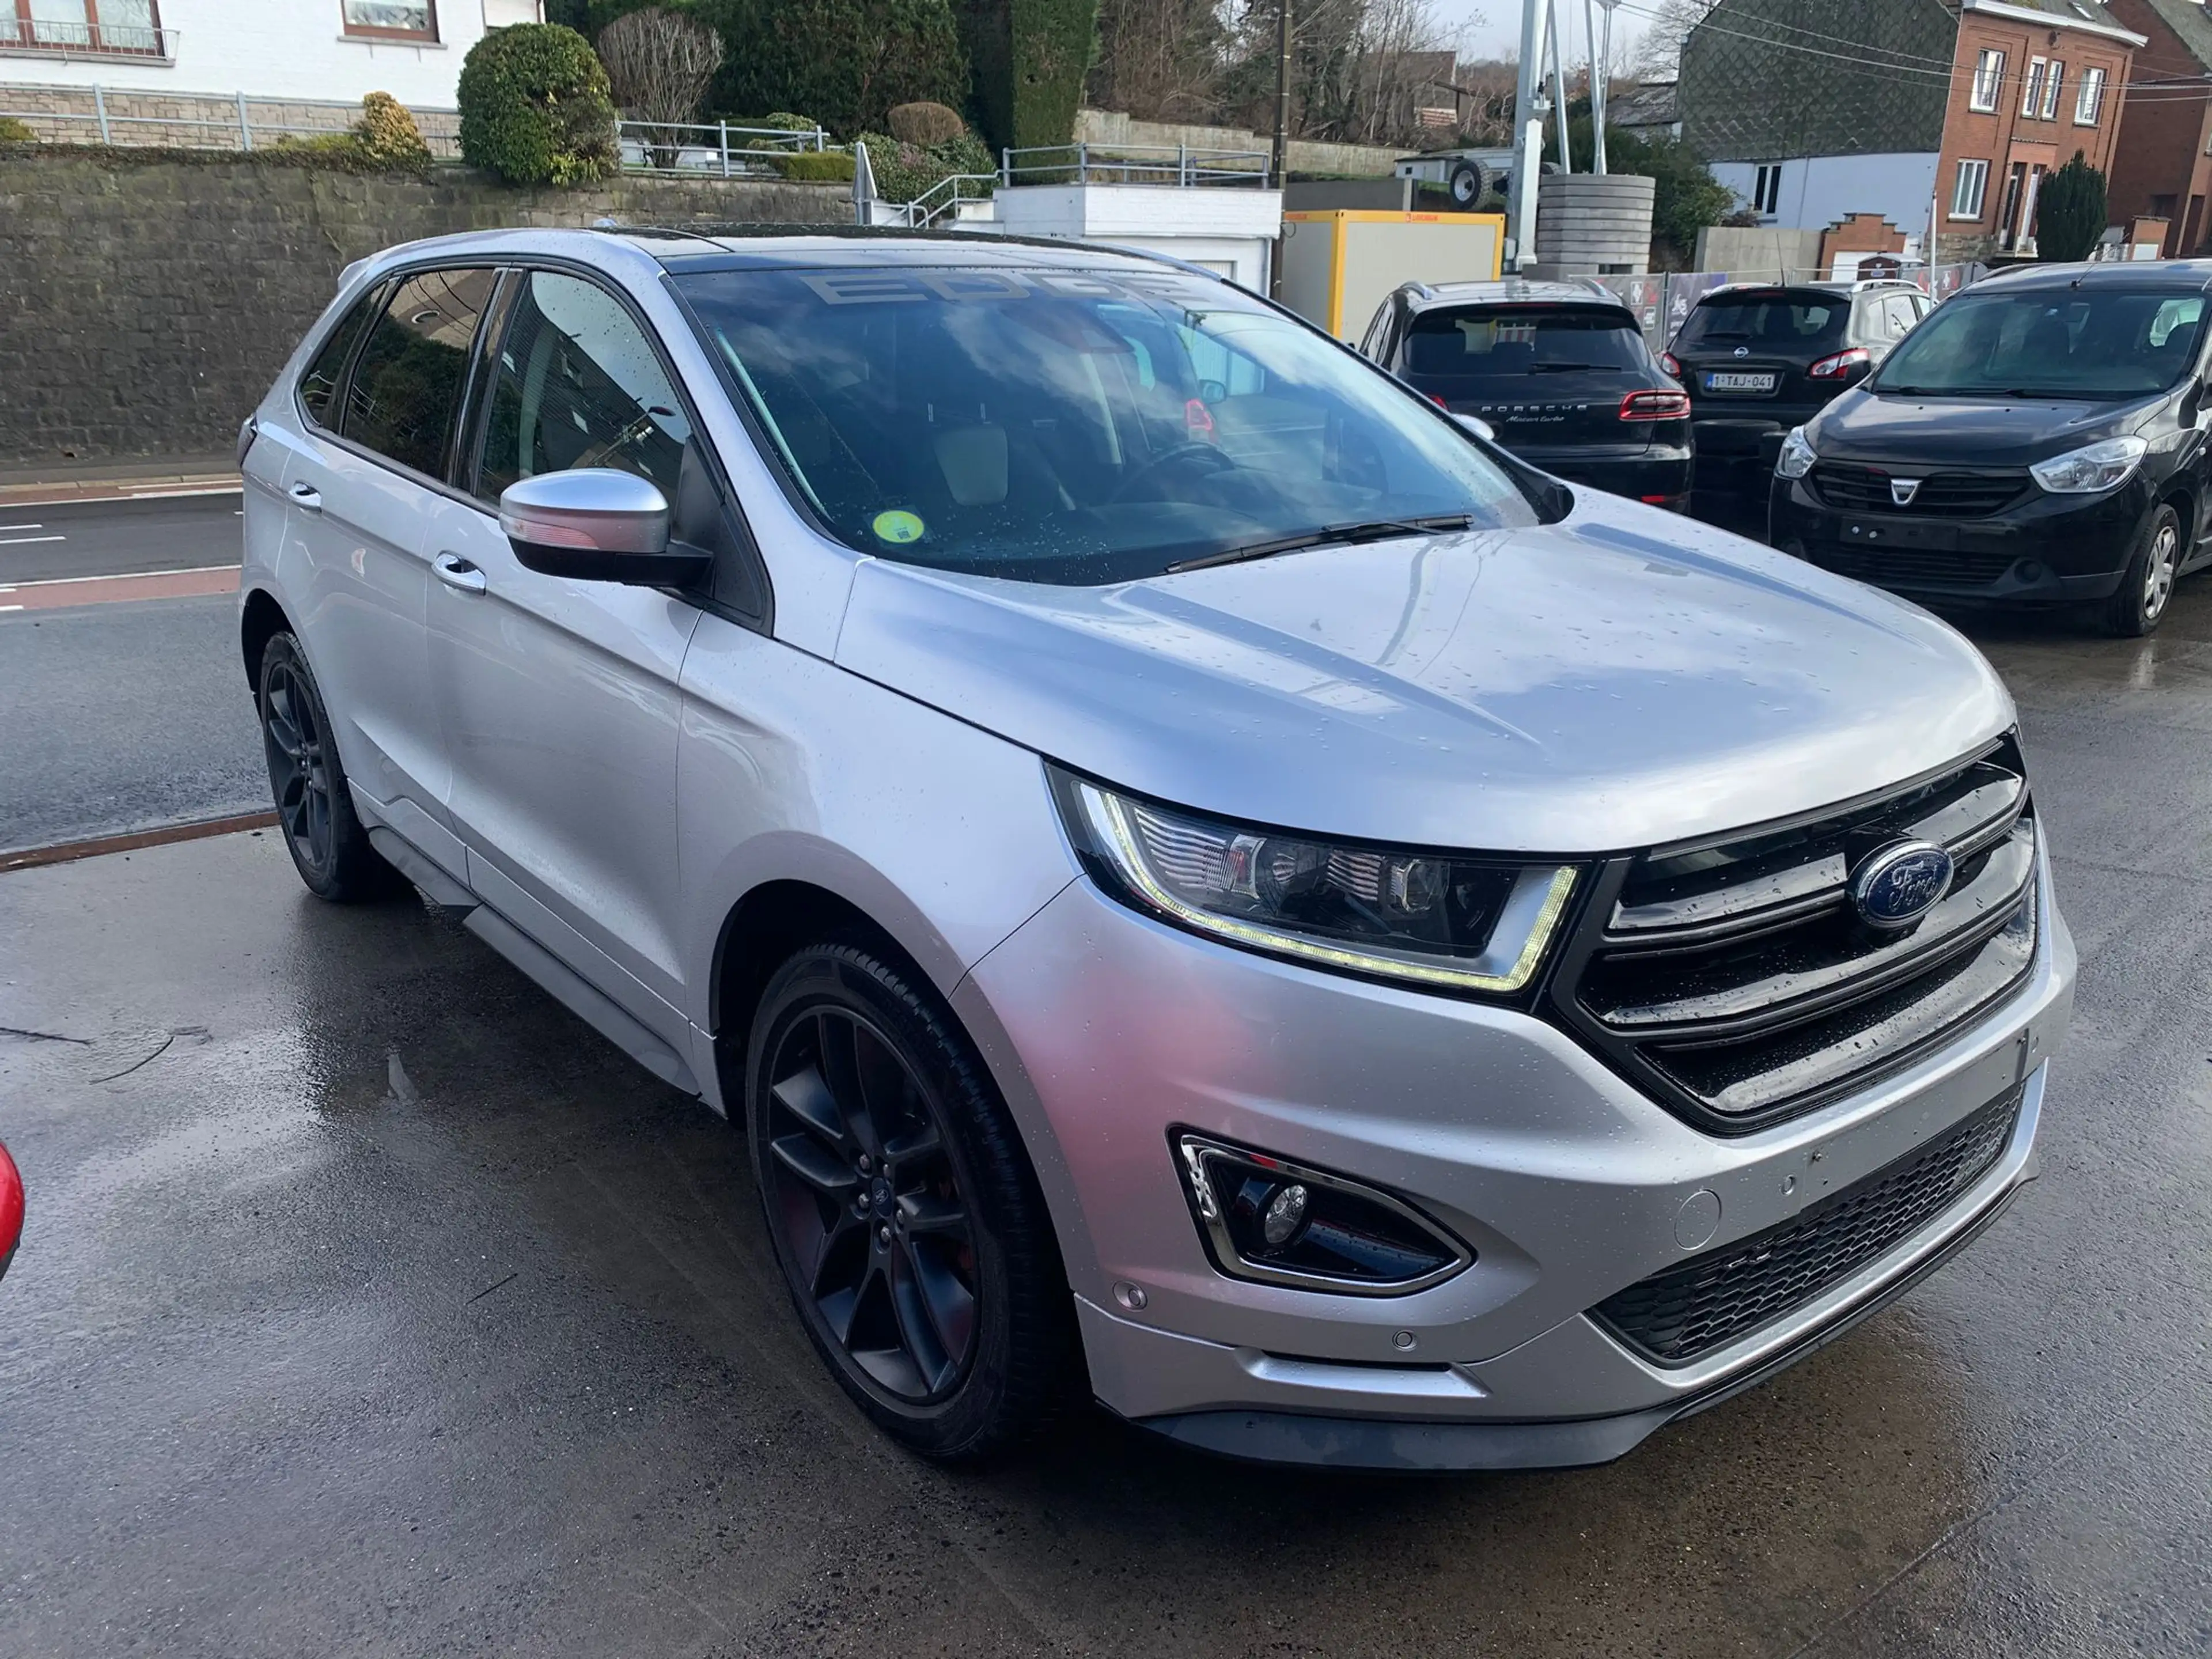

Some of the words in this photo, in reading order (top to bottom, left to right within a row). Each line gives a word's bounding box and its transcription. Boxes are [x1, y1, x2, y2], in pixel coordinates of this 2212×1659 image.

[798, 273, 1211, 305] EDGE
[1714, 376, 1772, 387] 1-TAJ-041
[1888, 861, 1939, 912] Ford
